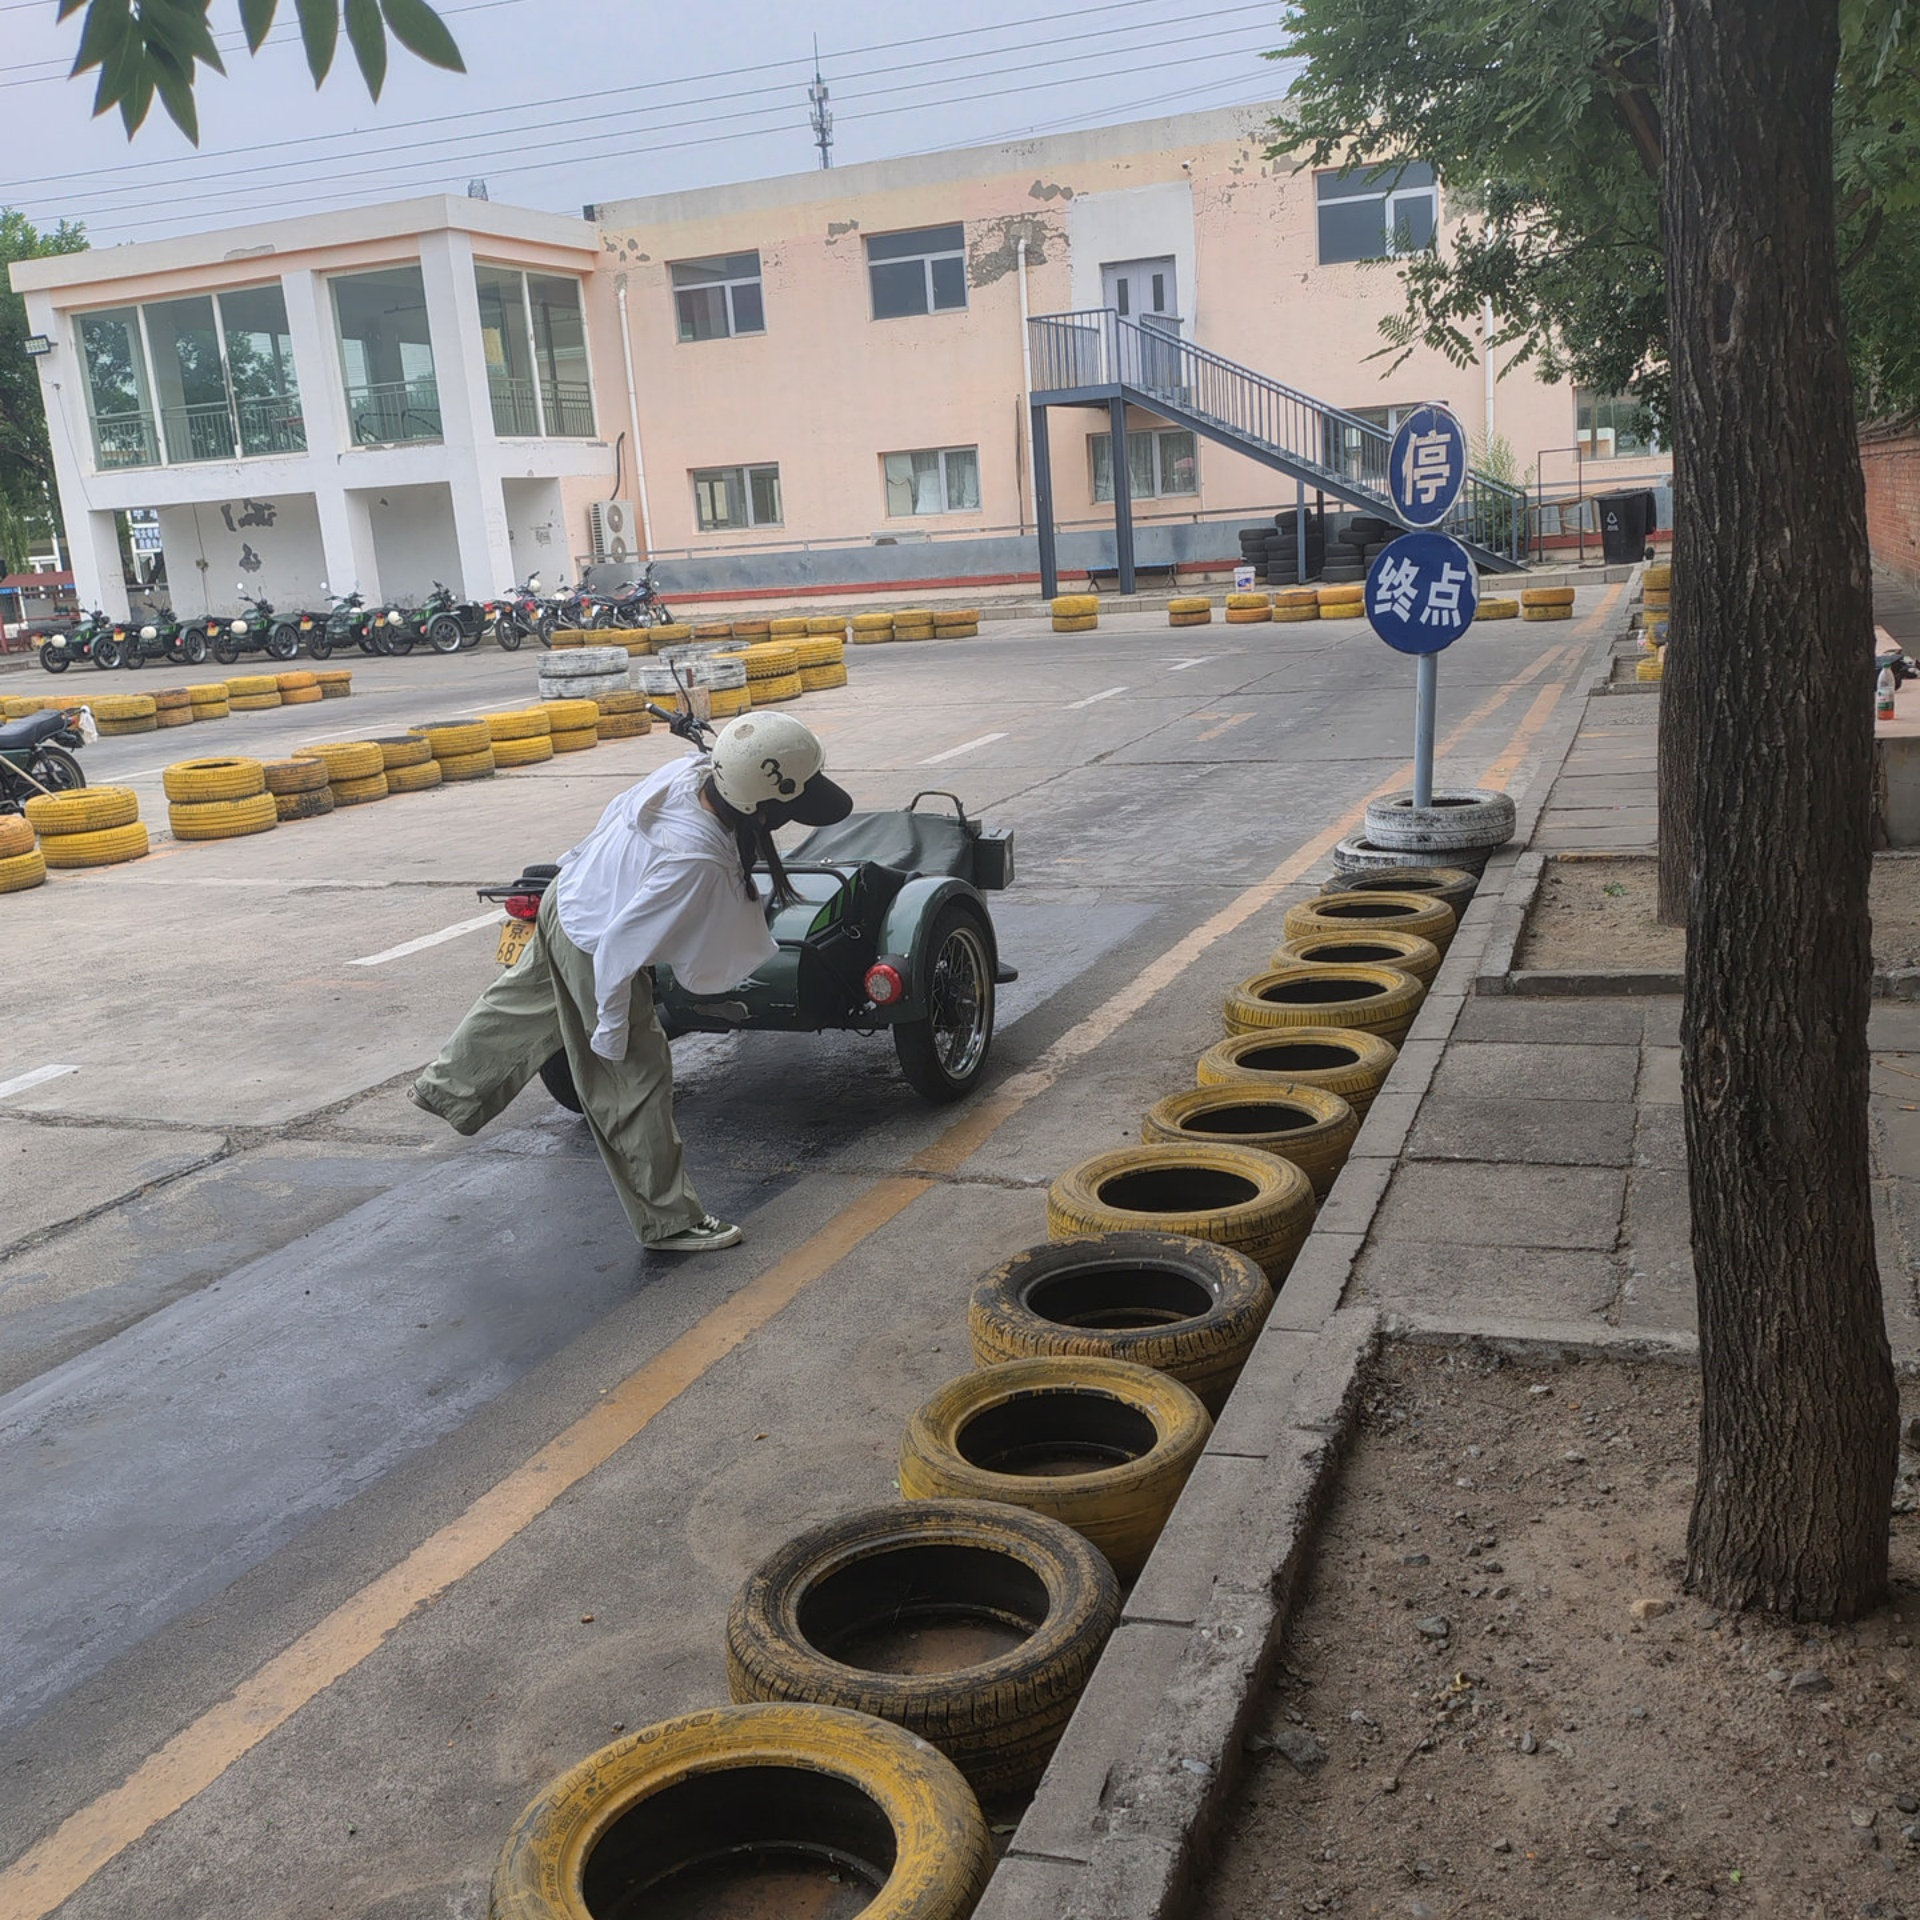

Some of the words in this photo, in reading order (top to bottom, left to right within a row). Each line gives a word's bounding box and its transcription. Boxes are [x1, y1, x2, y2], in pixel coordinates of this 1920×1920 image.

[1402, 430, 1451, 506] 停
[1374, 556, 1466, 628] 终点
[549, 1713, 714, 1809] LINGLONG
